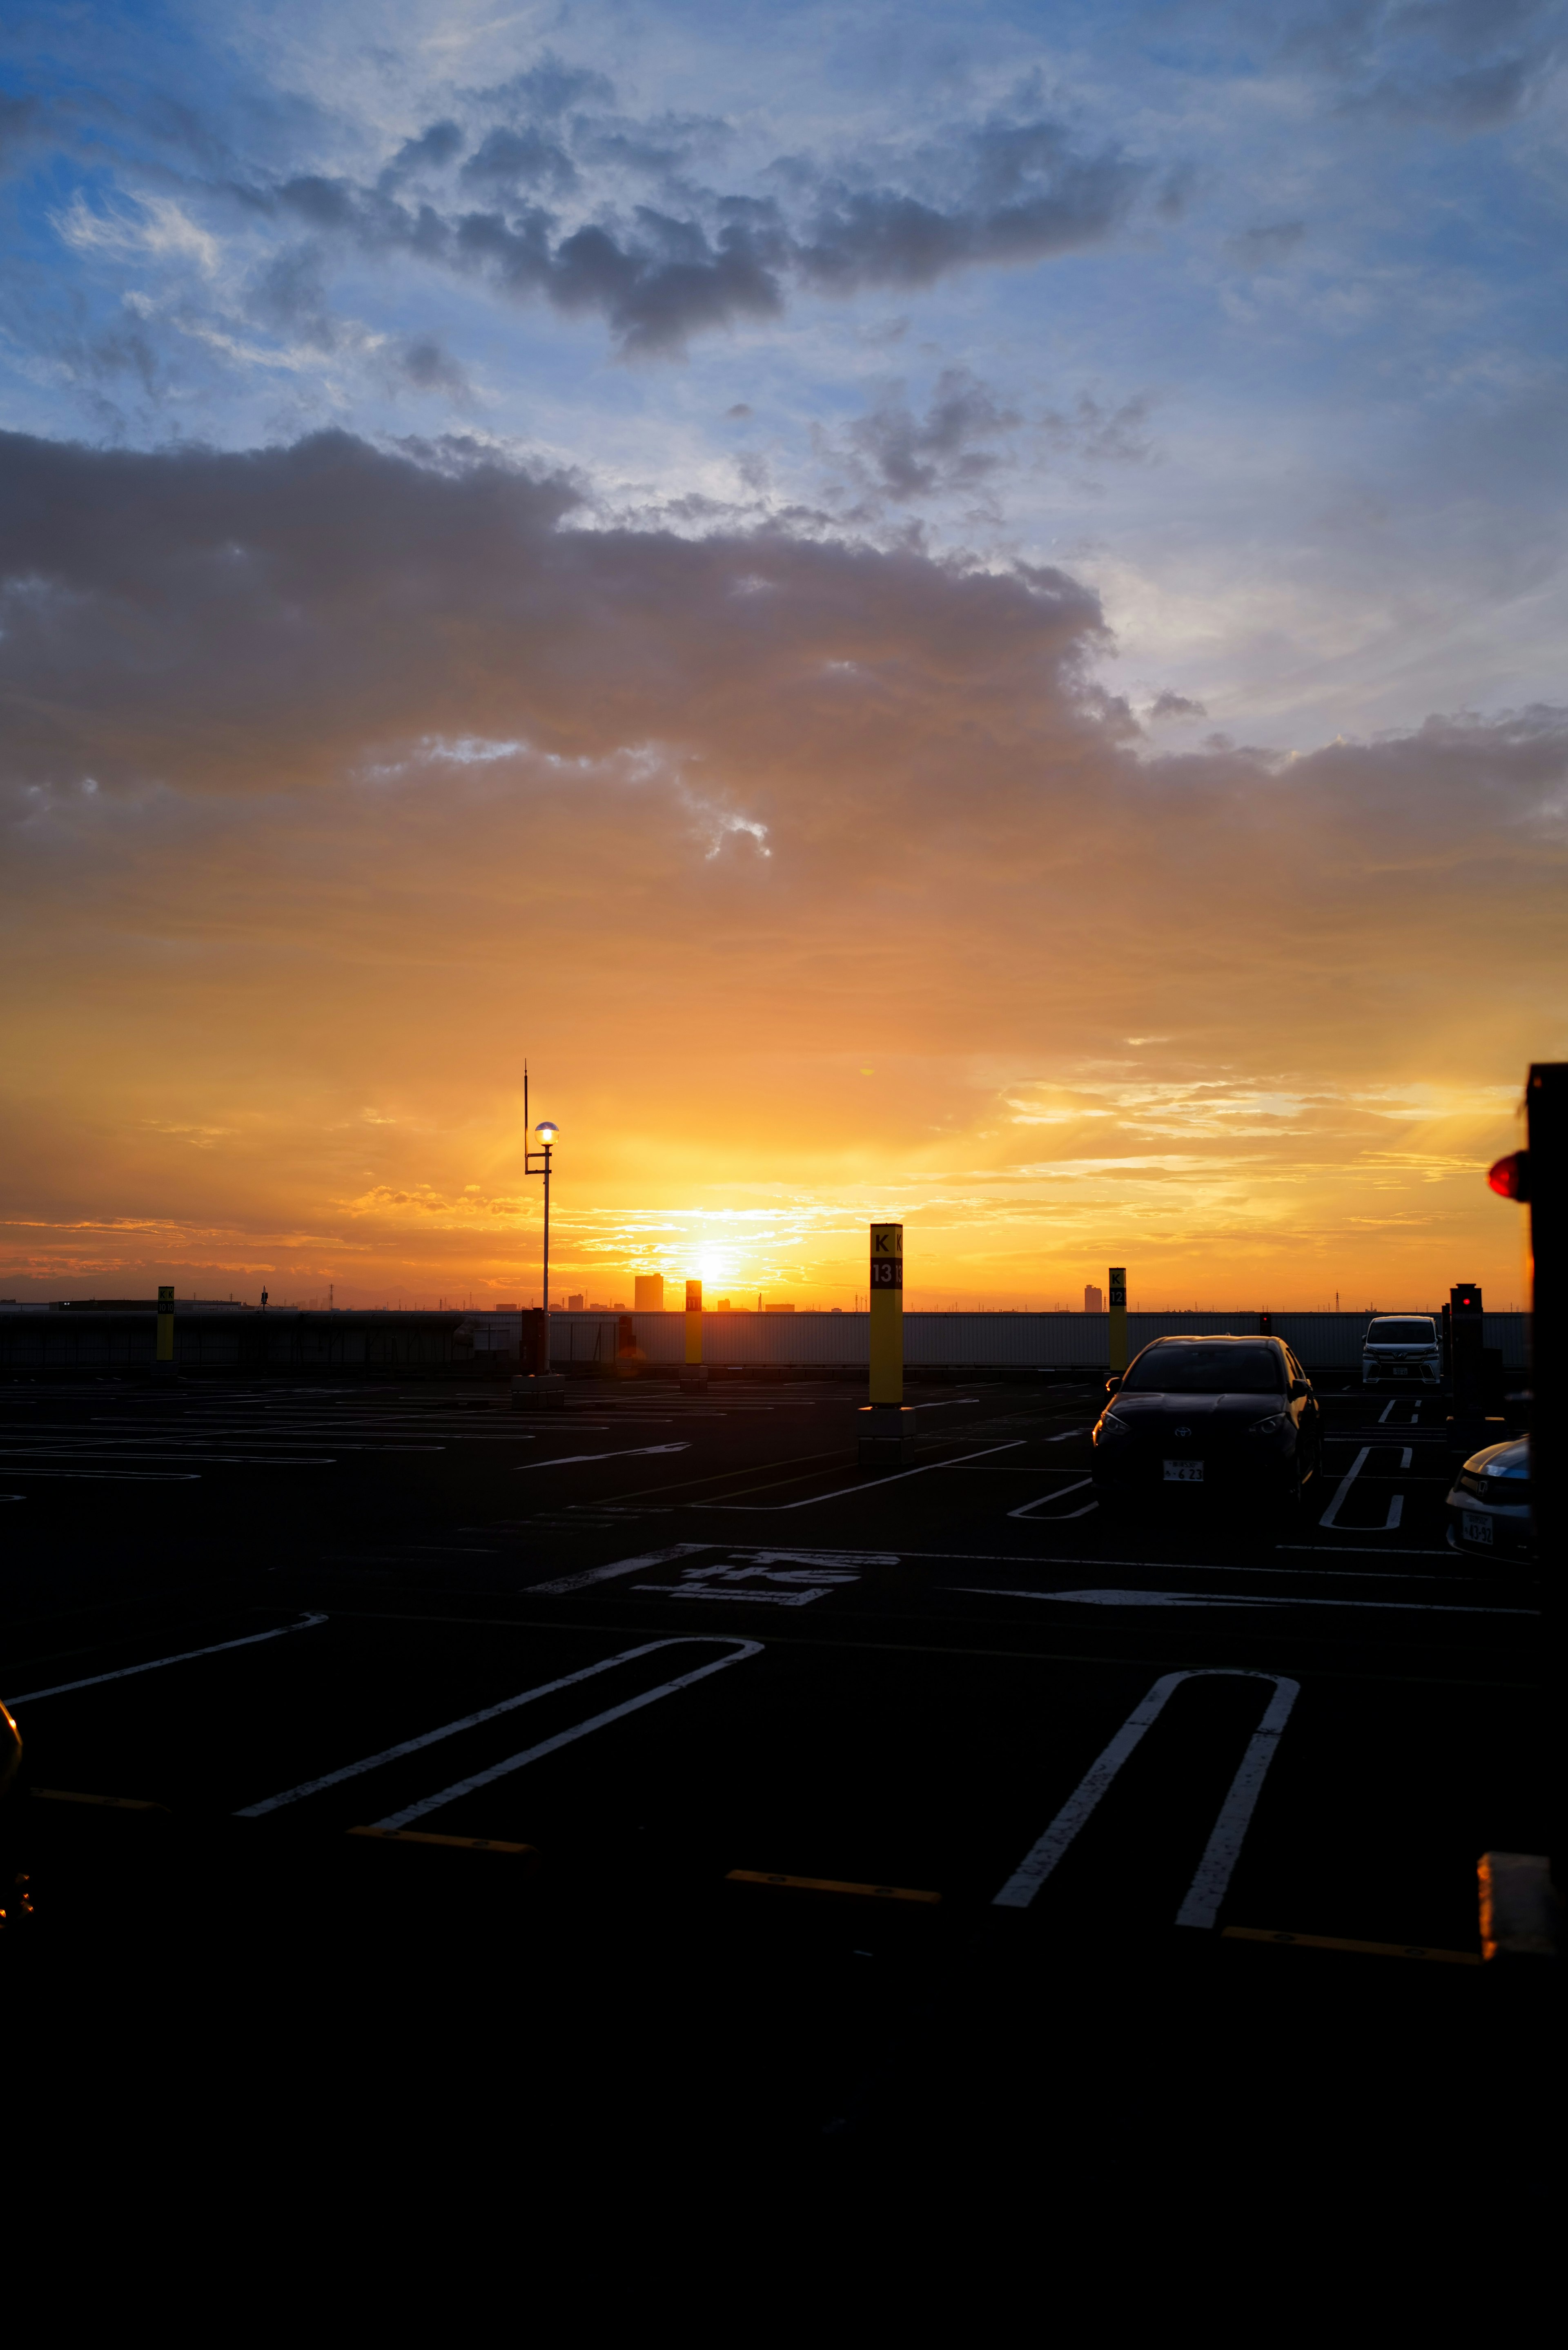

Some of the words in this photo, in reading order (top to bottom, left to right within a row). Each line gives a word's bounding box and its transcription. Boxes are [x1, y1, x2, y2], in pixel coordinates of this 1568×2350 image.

[876, 1234, 889, 1252] K
[897, 1234, 902, 1251] K
[873, 1264, 892, 1282] 13
[895, 1265, 902, 1283] 13
[1112, 1274, 1120, 1284] K
[688, 1285, 694, 1293] K
[1111, 1291, 1123, 1302] 12
[688, 1300, 695, 1308] 11
